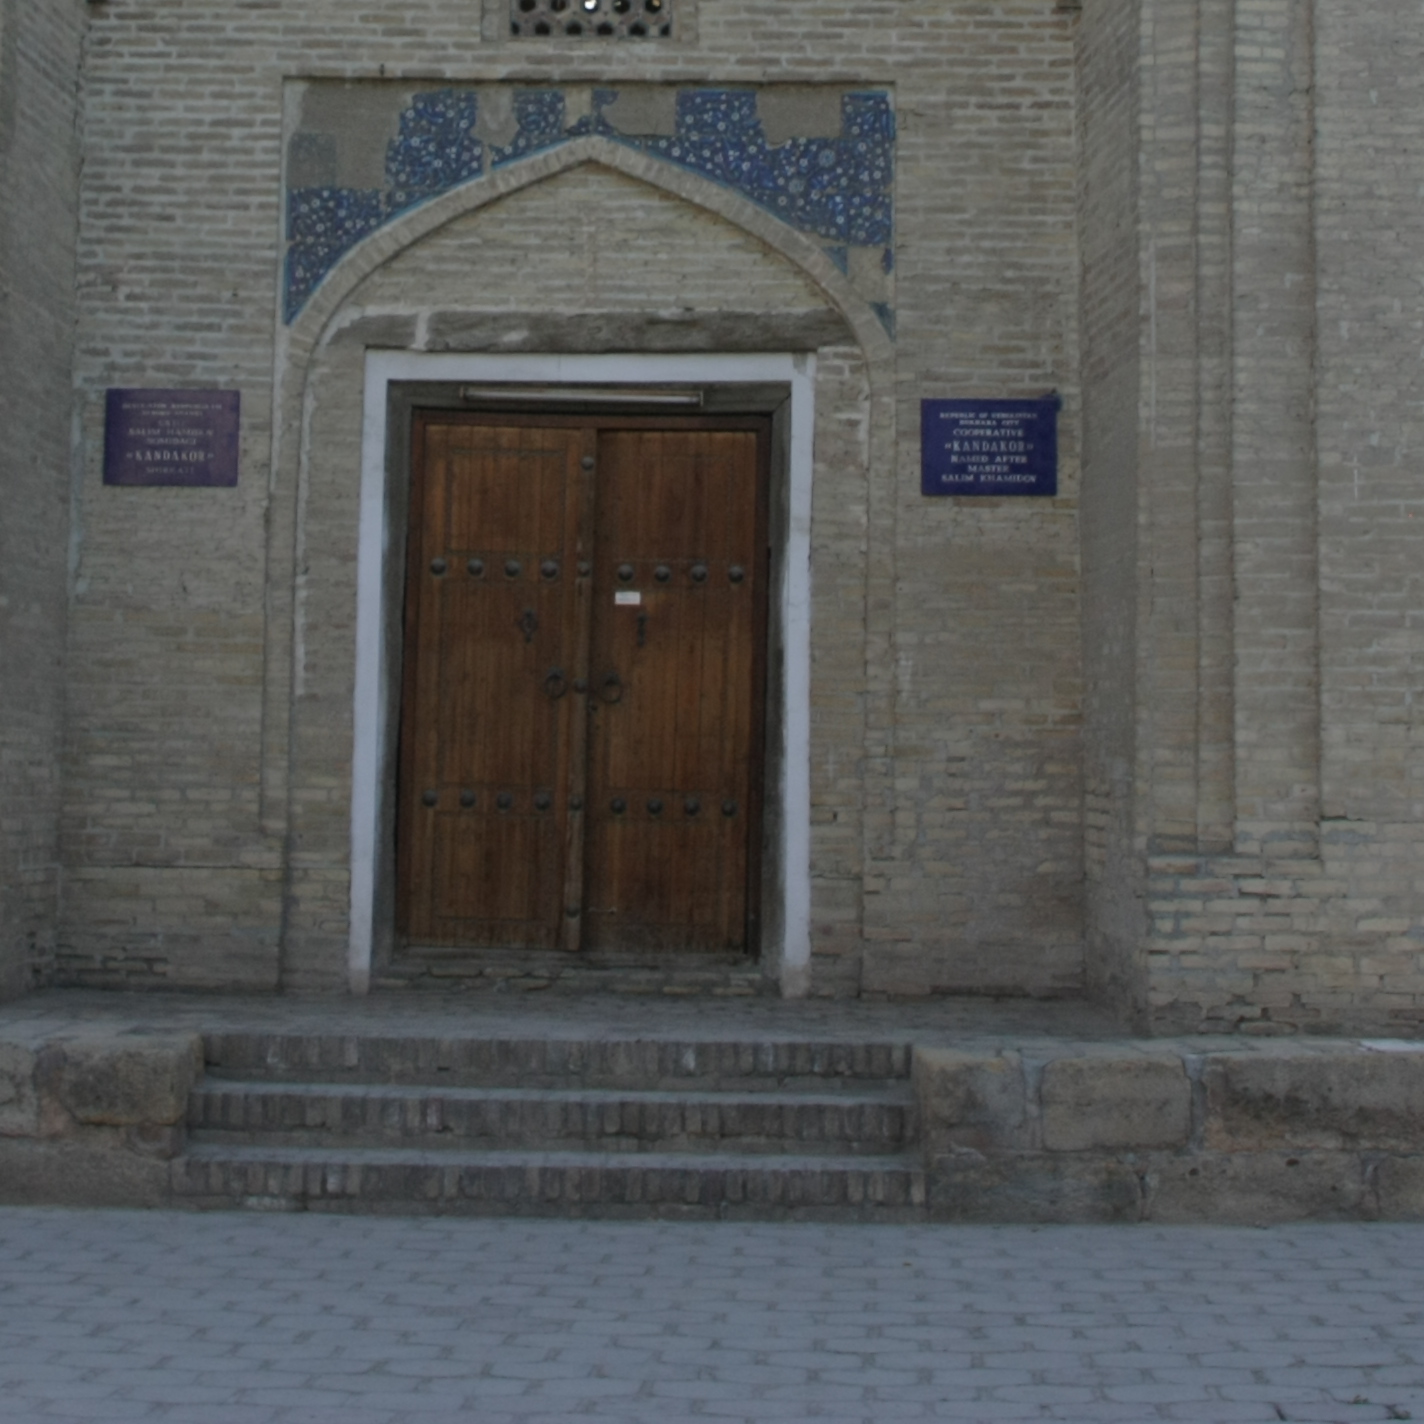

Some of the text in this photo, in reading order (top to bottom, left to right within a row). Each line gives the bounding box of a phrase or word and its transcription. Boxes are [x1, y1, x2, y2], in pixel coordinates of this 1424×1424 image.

[953, 428, 1024, 437] COOPERATIVE
[950, 455, 1028, 463] NAMED AFTER
[967, 464, 1009, 473] MASTER
[941, 474, 974, 482] SALIM
